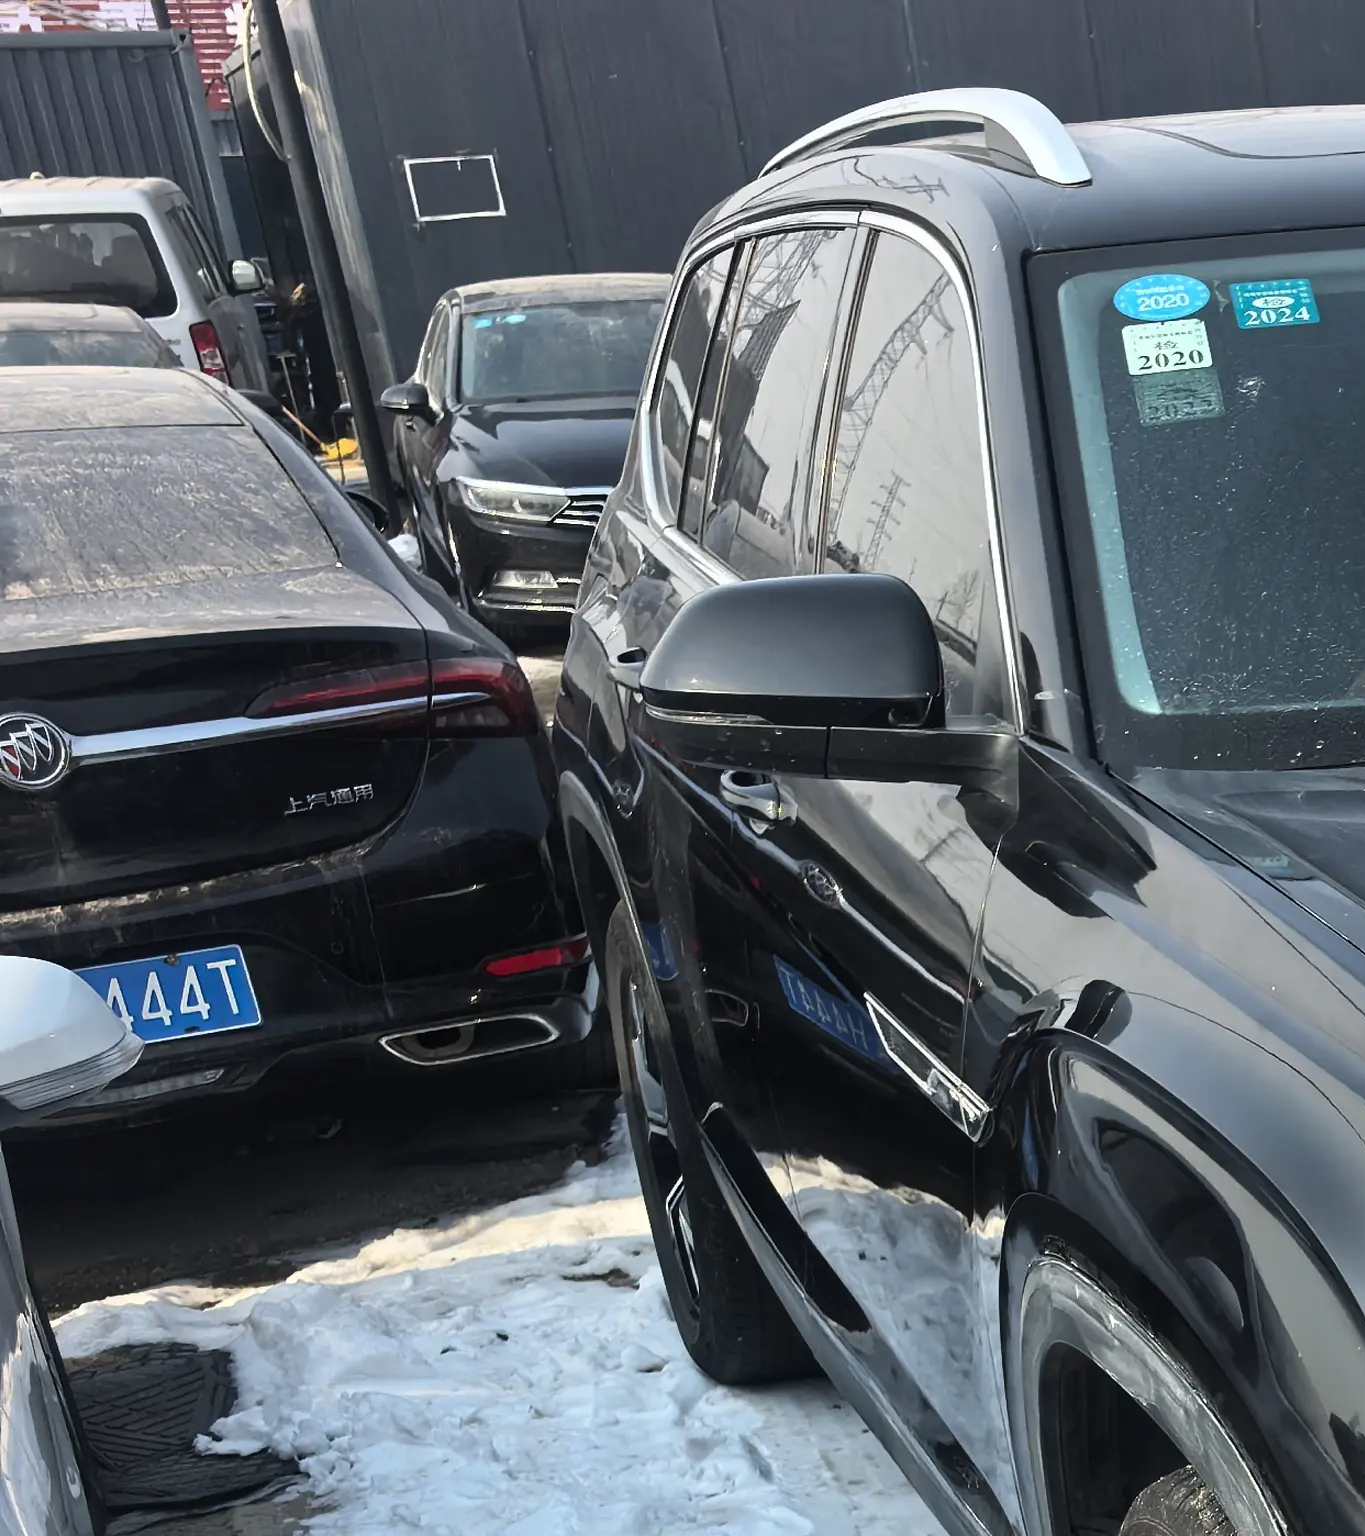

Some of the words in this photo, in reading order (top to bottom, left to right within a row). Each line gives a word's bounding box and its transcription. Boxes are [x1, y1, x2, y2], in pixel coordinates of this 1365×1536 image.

[1137, 292, 1190, 312] 2020
[1243, 306, 1311, 326] 2024
[1138, 349, 1204, 371] 2020
[284, 783, 374, 816] 上汽通用
